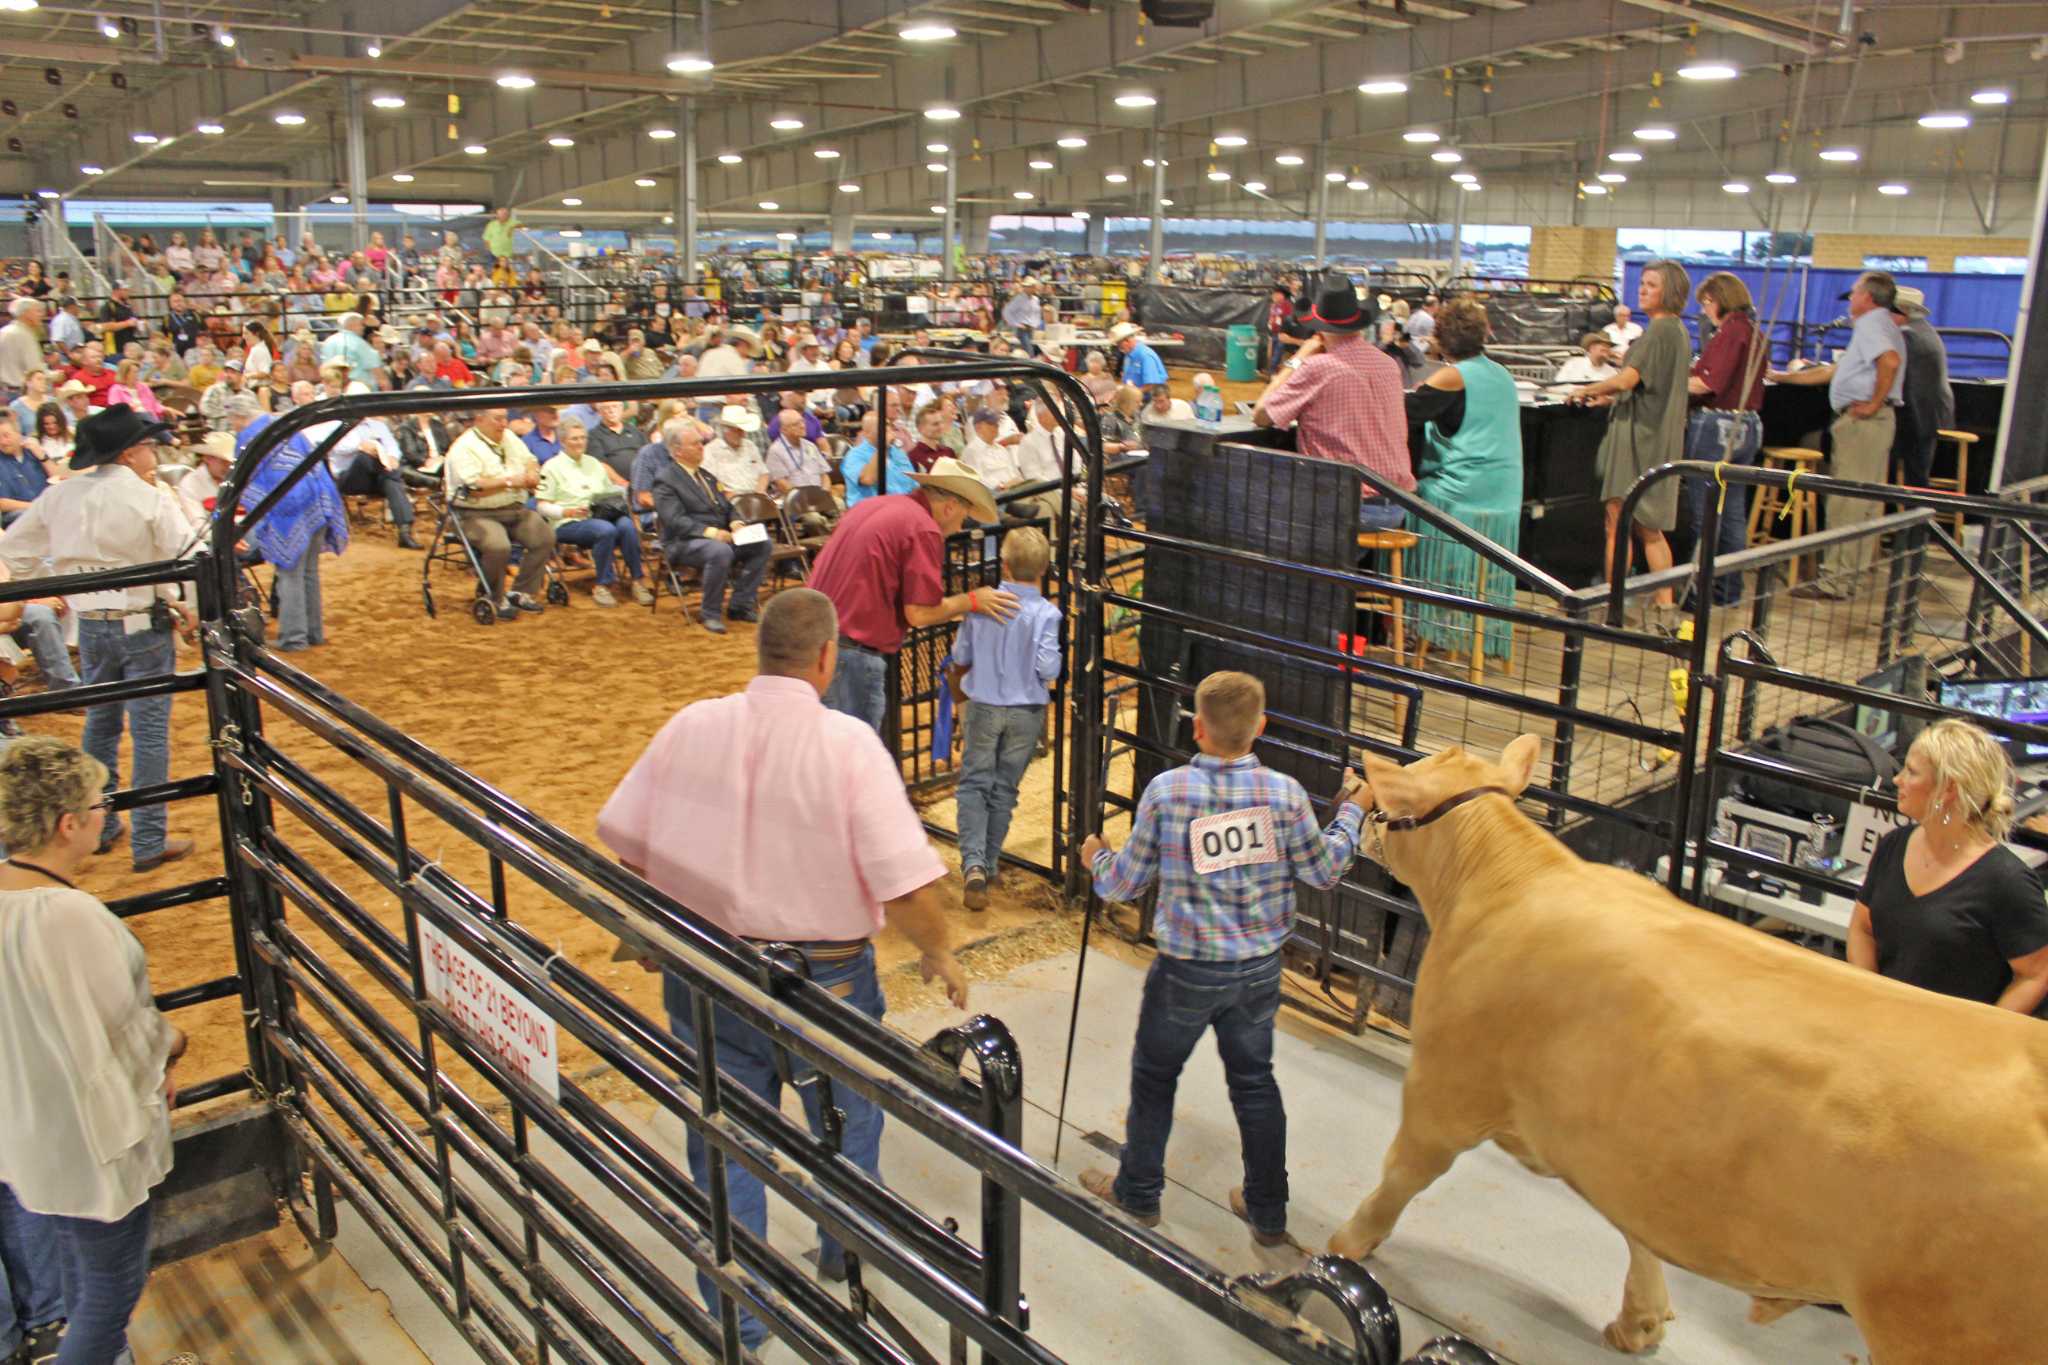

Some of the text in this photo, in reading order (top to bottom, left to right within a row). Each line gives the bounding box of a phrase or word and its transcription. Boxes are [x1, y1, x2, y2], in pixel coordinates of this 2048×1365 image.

[1203, 822, 1263, 857] 001
[424, 932, 548, 1059] THE AGE OF 21 BEYOND
[444, 988, 470, 1034] PAST
[497, 1034, 532, 1085] POINT
